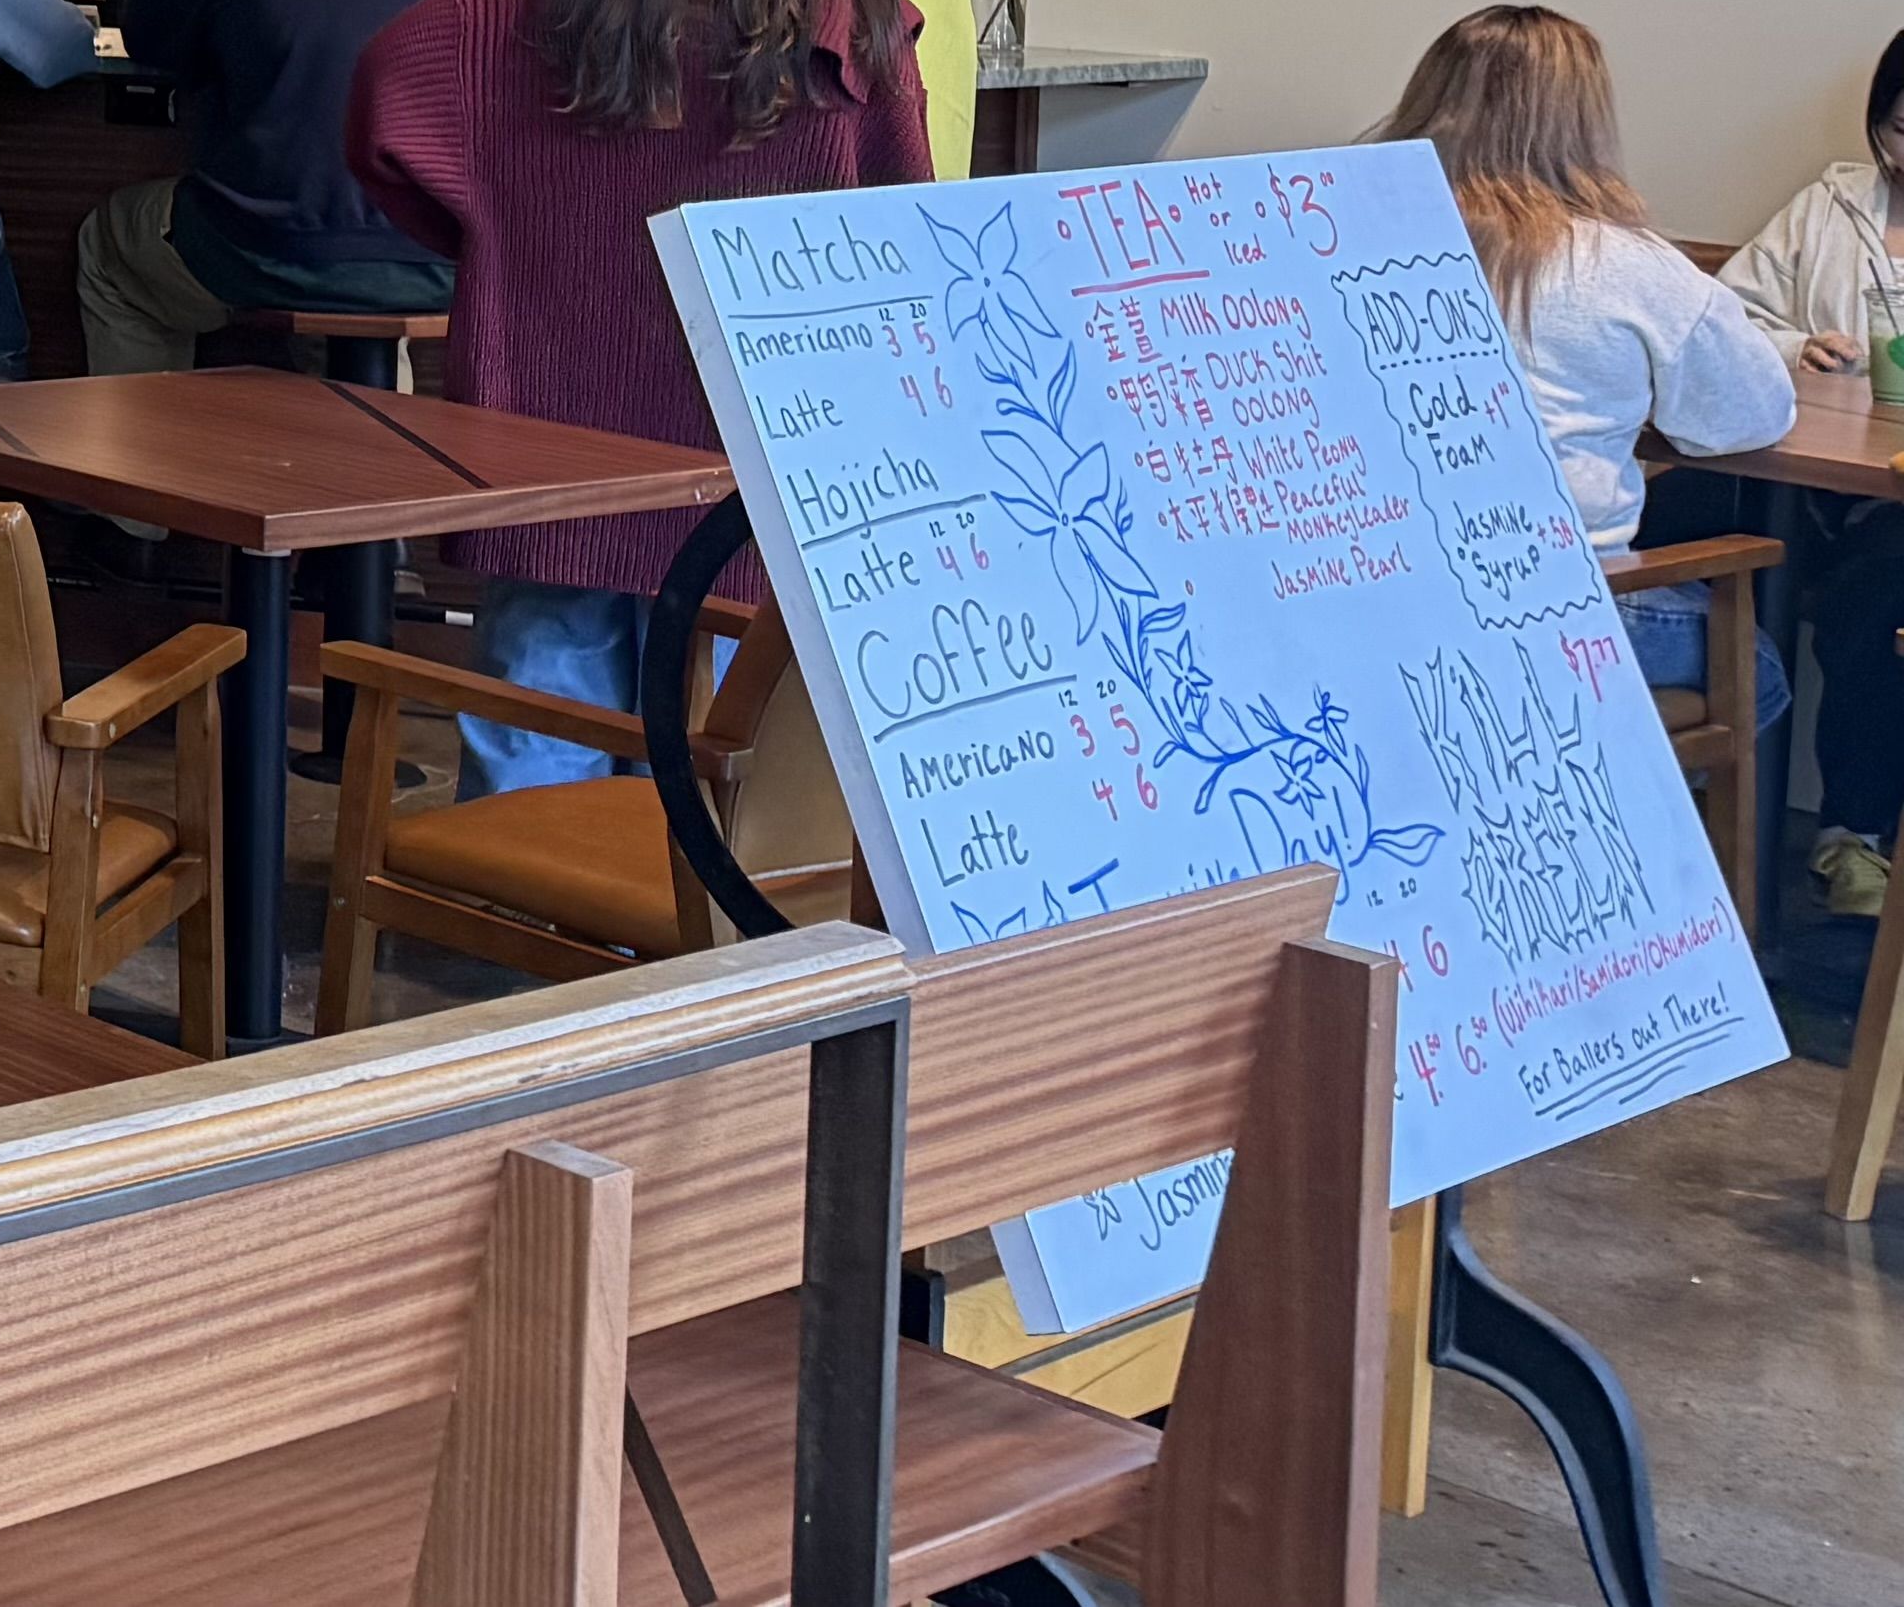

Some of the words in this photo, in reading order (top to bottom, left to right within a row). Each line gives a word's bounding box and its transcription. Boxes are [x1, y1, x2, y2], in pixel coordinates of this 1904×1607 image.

[1184, 172, 1222, 205] Hot
[1058, 178, 1185, 278] TEA
[1210, 211, 1231, 227] or
[712, 215, 911, 300] Matcha
[1224, 233, 1266, 266] Iced
[880, 307, 893, 322] 12
[910, 303, 927, 319] 20
[1362, 288, 1493, 355] ADD-ONS
[736, 323, 873, 366] Americano
[882, 325, 902, 357] 3
[913, 321, 936, 355] 5
[756, 389, 843, 440] Latte
[900, 375, 927, 417] 4
[934, 365, 953, 409] 6
[1409, 374, 1477, 428] Cold
[1239, 434, 1303, 480] White
[787, 447, 939, 540] Hojicha
[1274, 470, 1366, 515] Peaceful
[929, 521, 945, 538] 12
[956, 512, 974, 529] 20
[815, 542, 920, 611] Latte
[936, 545, 964, 581] 4
[970, 532, 989, 570] 6
[1350, 541, 1412, 583] Pearl
[858, 598, 1052, 719] Coffee
[1058, 689, 1078, 707] 12
[1096, 680, 1116, 698] 20
[1070, 714, 1095, 757] 3
[1110, 703, 1139, 756] 5
[920, 810, 1029, 887] Latte
[1092, 778, 1118, 821] 4
[1136, 763, 1158, 810] 6
[1366, 889, 1384, 908] 12
[1399, 878, 1417, 898] 20
[1423, 925, 1448, 976] 6
[1518, 1064, 1550, 1104] For
[1553, 1033, 1625, 1085] Ballers
[1631, 1017, 1664, 1047] out
[1664, 981, 1730, 1032] There!
[1135, 1154, 1232, 1251] Jasmin
